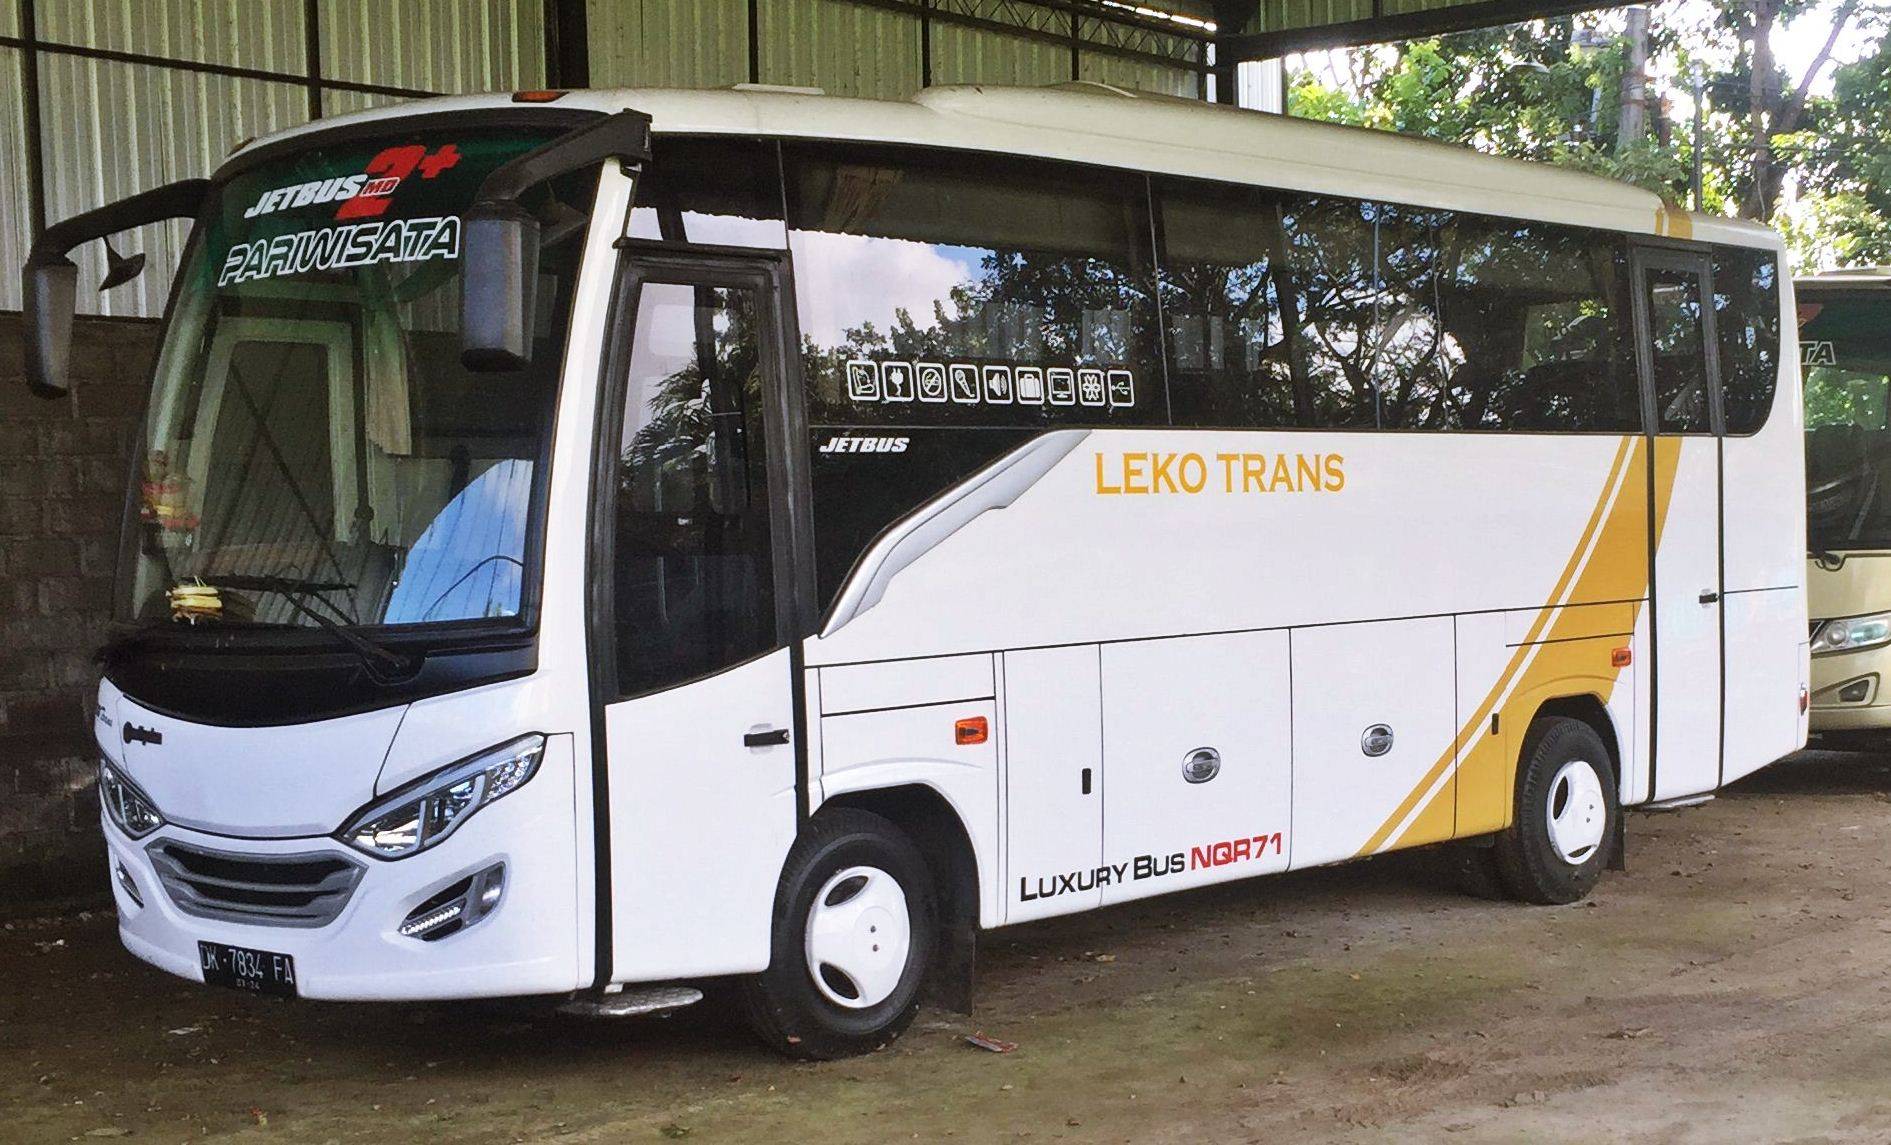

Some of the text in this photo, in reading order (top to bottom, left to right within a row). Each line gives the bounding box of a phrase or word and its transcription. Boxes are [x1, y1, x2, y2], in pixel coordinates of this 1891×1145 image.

[244, 174, 368, 219] JETBUS
[362, 177, 399, 197] MD
[218, 215, 461, 287] PARIWISATA
[819, 437, 910, 453] JETBUS
[1095, 452, 1345, 494] LEKO TRANS
[1020, 832, 1281, 902] LUXURY BUS NQR71
[200, 945, 294, 985] DK 7834 FA
